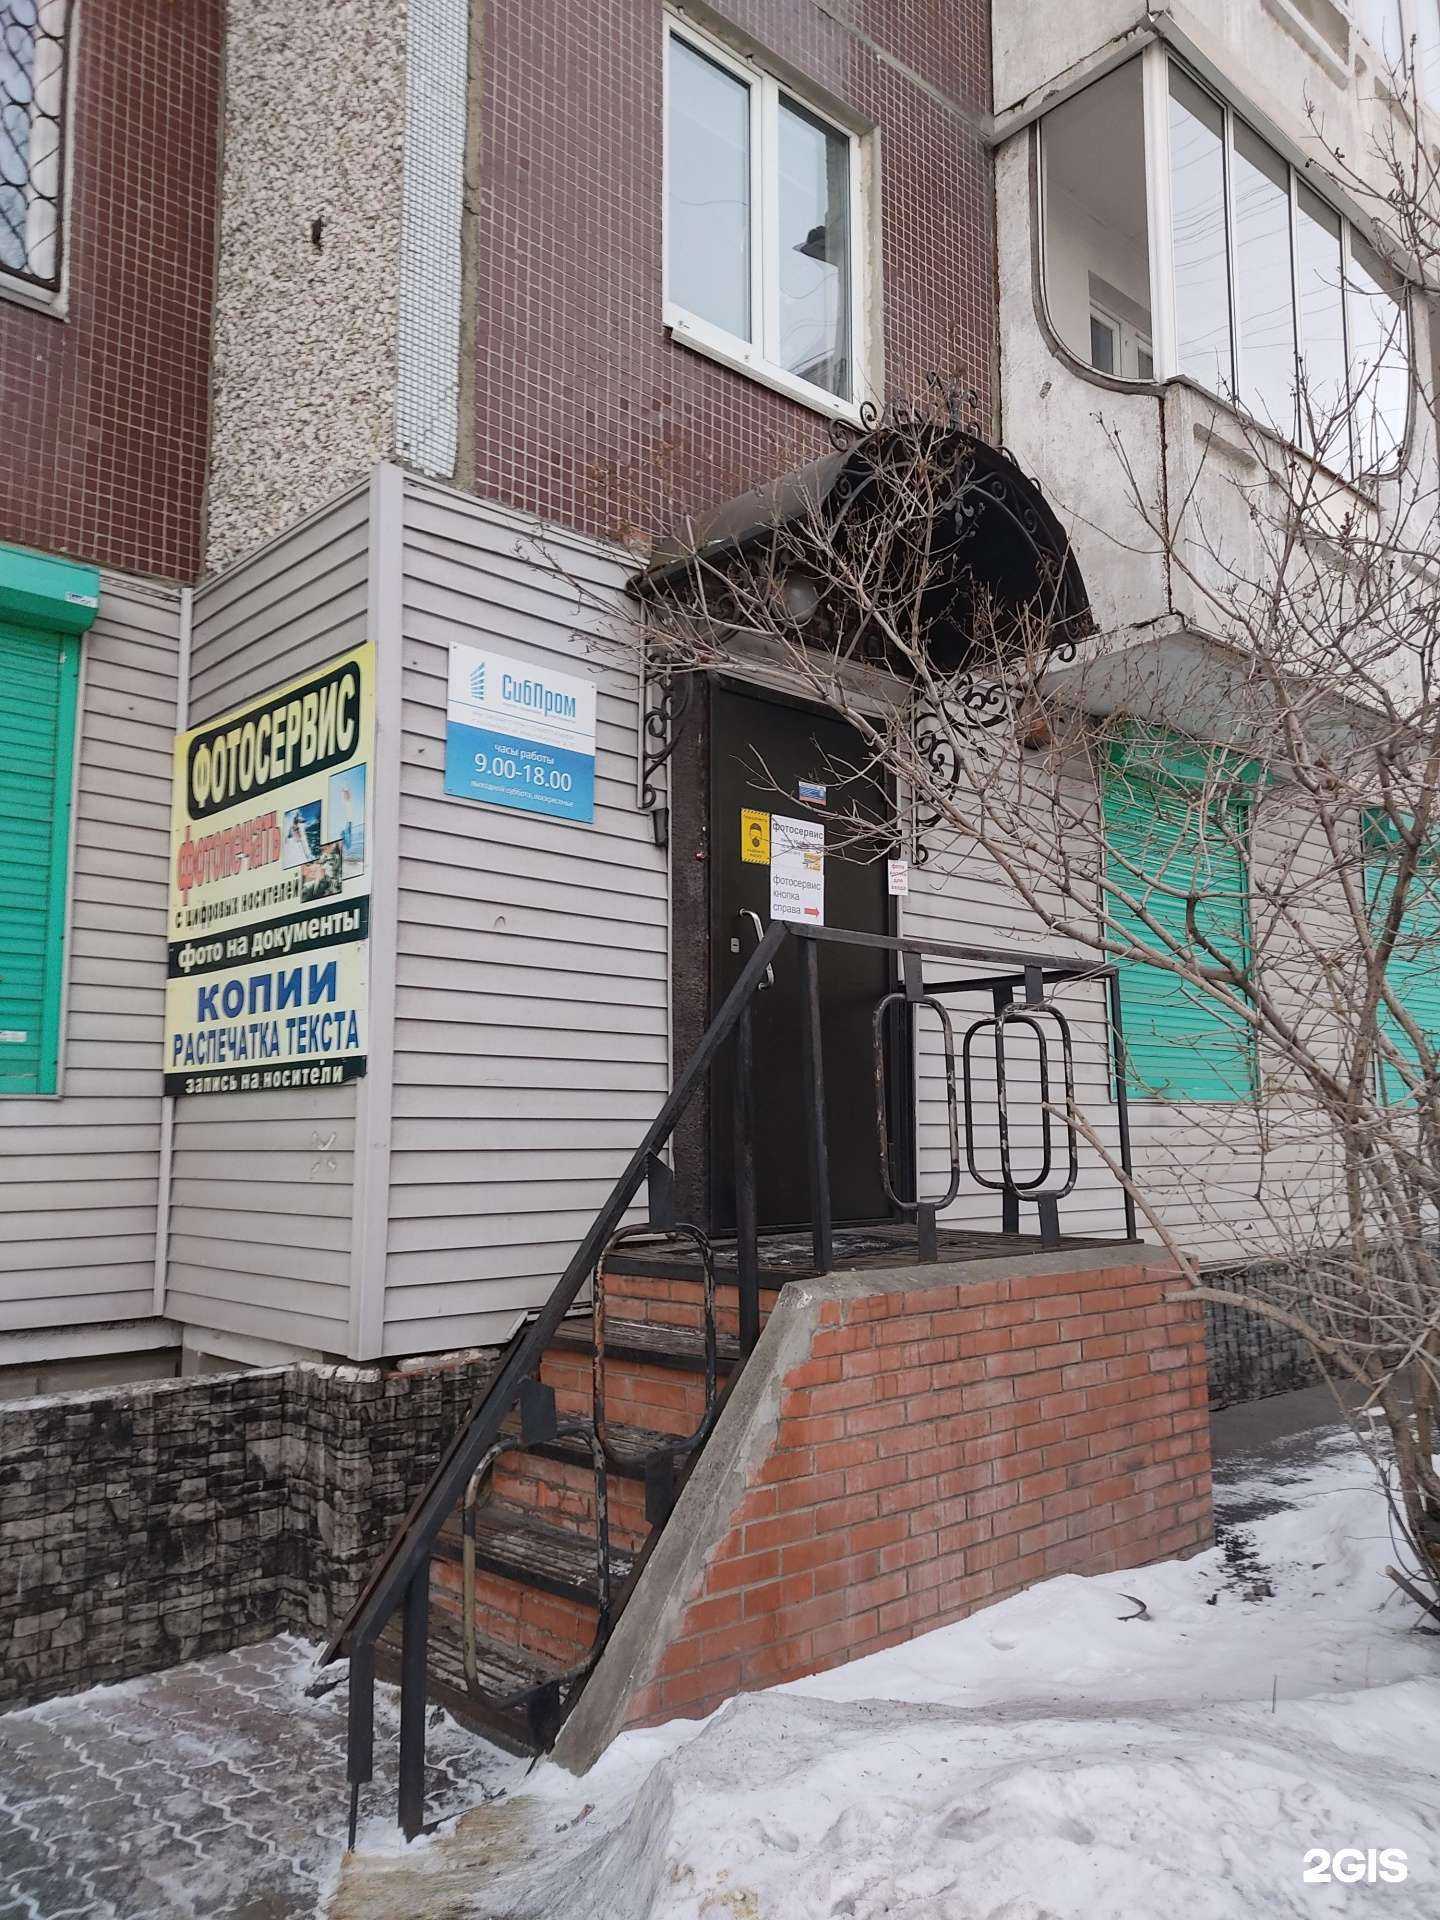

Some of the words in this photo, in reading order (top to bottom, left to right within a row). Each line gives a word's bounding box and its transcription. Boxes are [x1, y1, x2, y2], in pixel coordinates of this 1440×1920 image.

[502, 674, 576, 717] СибПром
[192, 673, 355, 808] ФОТОСЕРВИС
[494, 743, 519, 756] часы
[520, 749, 555, 765] работы
[474, 753, 572, 792] 9.00-18.00
[773, 822, 824, 840] фотосервис
[185, 898, 239, 929] цифровых
[241, 872, 299, 912] носителей
[773, 874, 821, 891] фотосервис
[773, 890, 800, 900] кнопка
[773, 904, 800, 914] справа
[178, 941, 222, 973] фото
[226, 935, 248, 960] на
[251, 908, 361, 958] документы
[198, 961, 337, 1023] КОПИИ
[172, 1021, 280, 1067] РАСПЕЧАТКА
[286, 1010, 360, 1056] ТЕКСТА
[185, 1072, 237, 1094] запись
[241, 1071, 259, 1090] на
[263, 1063, 344, 1087] носители
